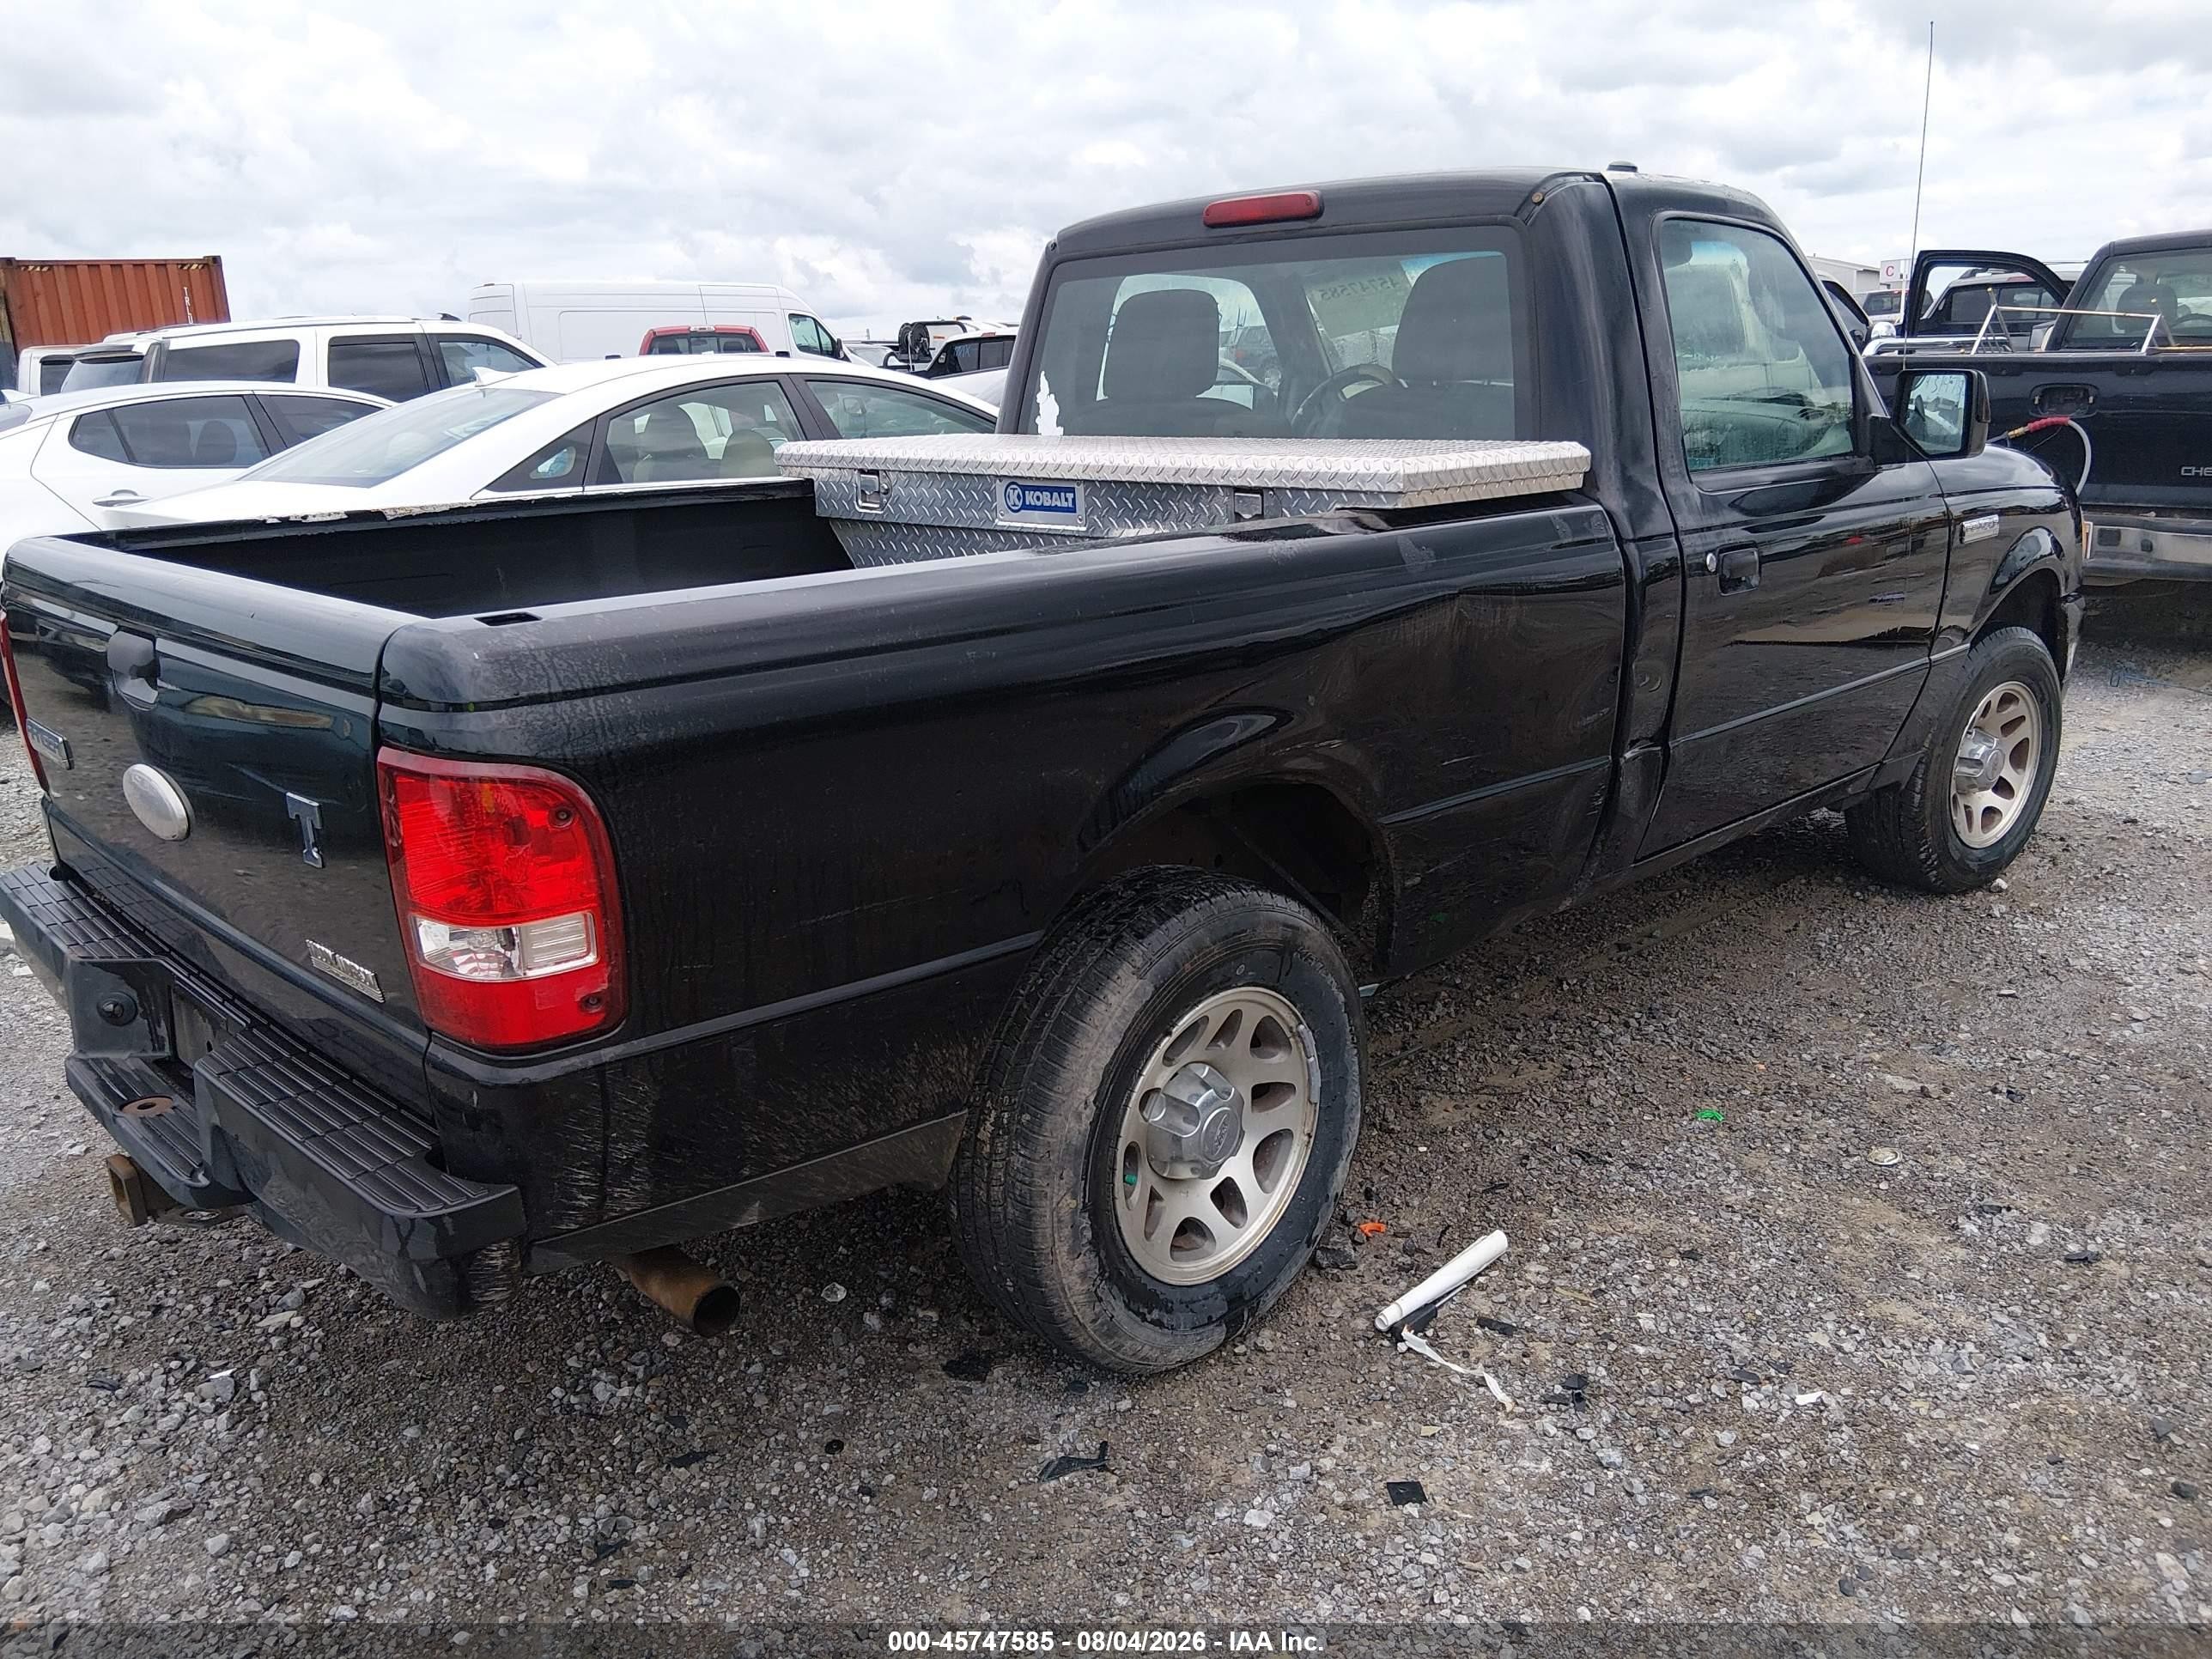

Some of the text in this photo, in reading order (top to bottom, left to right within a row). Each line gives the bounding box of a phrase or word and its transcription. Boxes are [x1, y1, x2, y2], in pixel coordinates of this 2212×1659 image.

[1886, 265, 1894, 276] C
[1024, 490, 1074, 507] KOBALT
[286, 792, 323, 868] T
